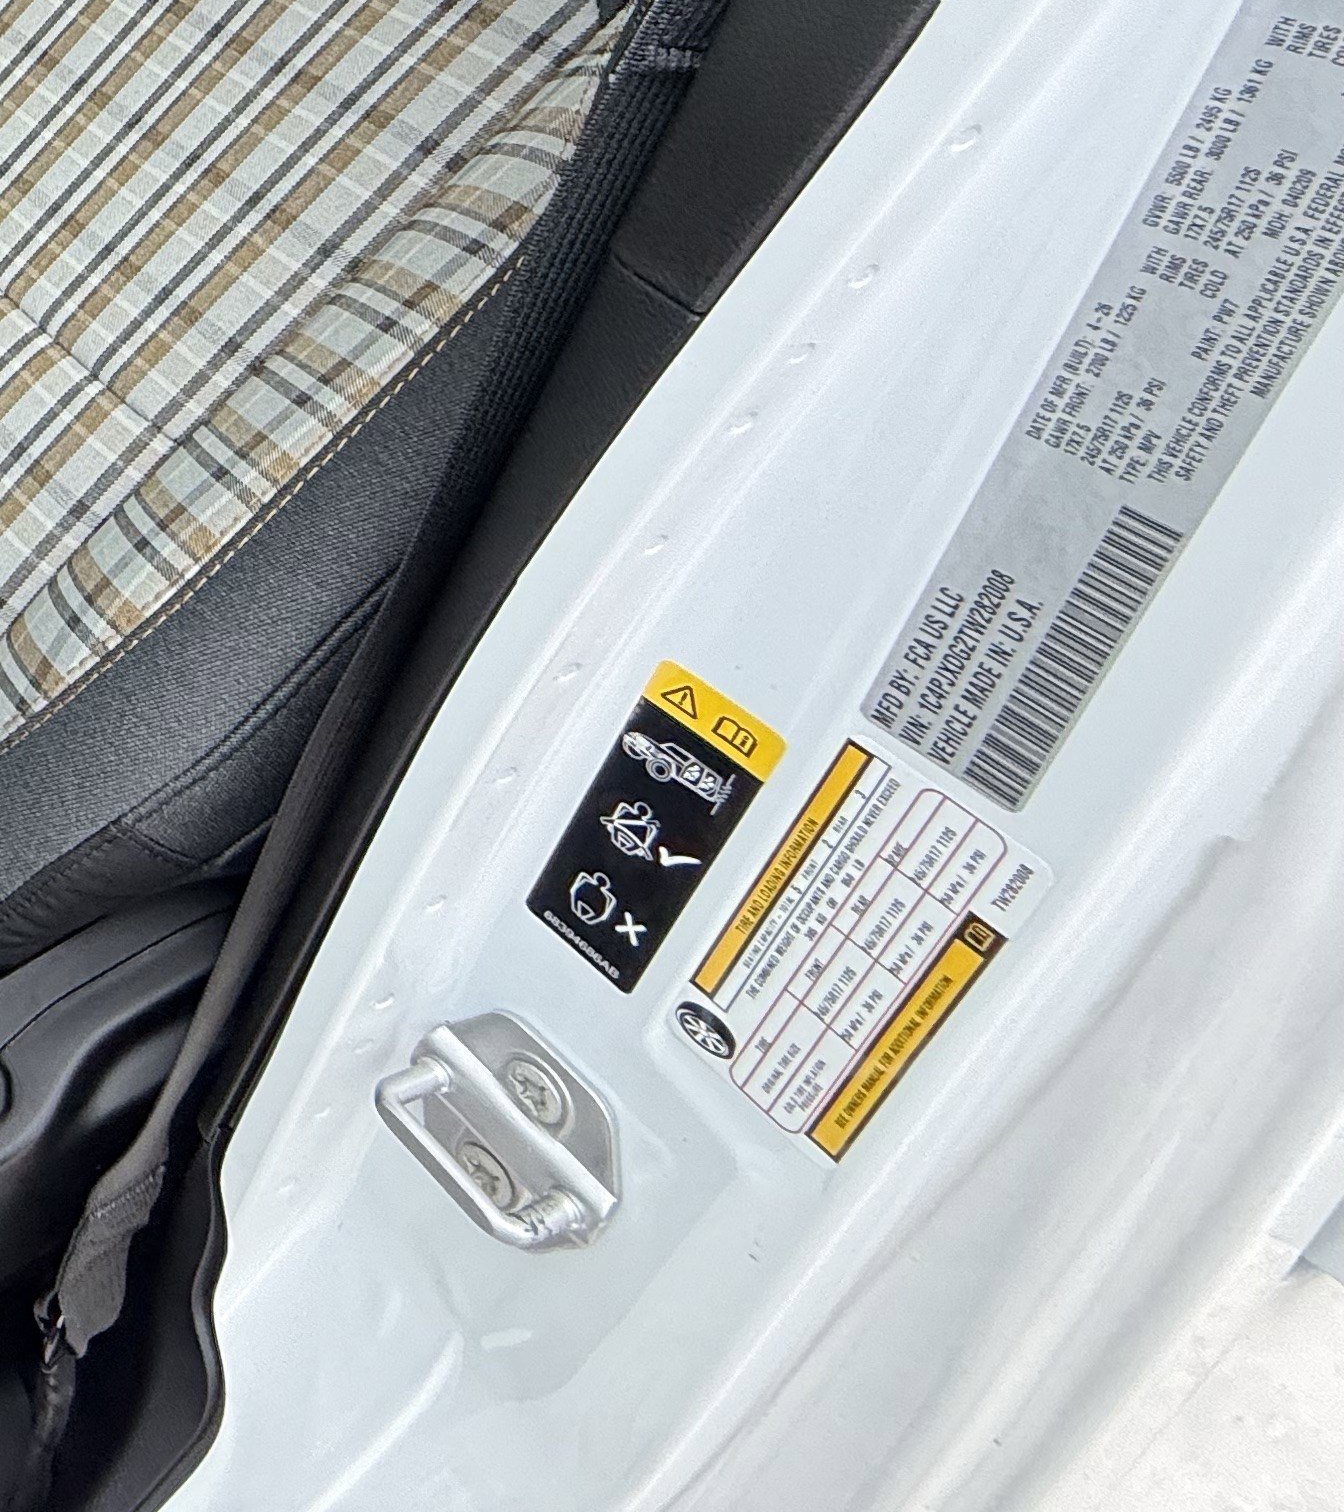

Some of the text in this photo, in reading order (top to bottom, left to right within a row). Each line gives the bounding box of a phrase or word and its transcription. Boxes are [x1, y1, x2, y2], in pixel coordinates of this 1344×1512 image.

[1286, 23, 1317, 54] RIMS
[1235, 166, 1261, 193] 112S
[1307, 25, 1342, 59] TIRES
[1163, 201, 1194, 235] GAWR
[1221, 117, 1241, 133] LB
[1251, 59, 1274, 76] KG
[1265, 16, 1296, 47] WITH
[1142, 194, 1172, 227] GVWR:
[1165, 160, 1191, 186] 5500
[1179, 144, 1201, 159] LB
[1209, 87, 1232, 104] KG
[1273, 149, 1298, 170] PSI
[1265, 171, 1286, 186] 36
[1303, 171, 1344, 221] FEDERAL
[1234, 220, 1258, 241] 250
[1223, 241, 1244, 259] AT
[1159, 254, 1187, 283] RIMS
[1199, 270, 1229, 299] COLD
[1244, 258, 1294, 323] APPLICABLE
[1045, 418, 1073, 449] GAWR
[1085, 352, 1110, 378] 2700
[1098, 337, 1118, 353] LB
[1126, 285, 1147, 302] KG
[1140, 246, 1169, 275] WITH
[1109, 390, 1133, 415] 112S
[1178, 258, 1209, 290] TIRES
[1230, 324, 1256, 346] ALL
[1251, 276, 1336, 398] MANUFACTURE SHOWN
[1175, 235, 1334, 481] SAFETY AND THEFT PREVENTION STANDARDS IN
[1219, 343, 1243, 360] TO
[1048, 375, 1072, 399] MFR
[1143, 377, 1166, 398] PSI
[1188, 360, 1232, 417] CONFORMS
[1040, 397, 1058, 414] OF
[1136, 397, 1155, 412] 36
[1025, 412, 1052, 440] DATE
[1163, 417, 1199, 459] VEHICLE
[1108, 440, 1129, 460] 250
[1137, 430, 1162, 455] MPV
[1098, 458, 1118, 476] AT
[1147, 458, 1174, 483] THIS
[871, 587, 964, 728] MFD BY: FCA US LLC
[928, 599, 1043, 764] VEHICLE MADE IN: U.S.A.
[899, 715, 932, 745] VIN:
[790, 884, 804, 899] 5
[801, 859, 818, 880] FRONT
[821, 839, 835, 850] 2
[832, 815, 848, 833] REAR
[854, 789, 867, 800] 3
[735, 818, 818, 934] TIRE AND LOADING INFORMATION
[745, 778, 901, 999] THE COMBINED WEIGHT OF OCCUPANTS AND CARGO SHOULD NEVER EXCEED
[826, 897, 838, 910] OR
[868, 989, 883, 1004] PSI
[917, 921, 934, 936] PSI
[969, 849, 987, 865] PSI
[754, 1036, 771, 1055] TIRE
[805, 958, 823, 982] FRONT
[834, 1113, 850, 1129] SEE
[861, 1067, 885, 1092] MANUAL
[878, 1051, 894, 1068] FOR
[889, 1018, 921, 1055] ADDITIONAL
[916, 975, 953, 1019] INFORMATION
